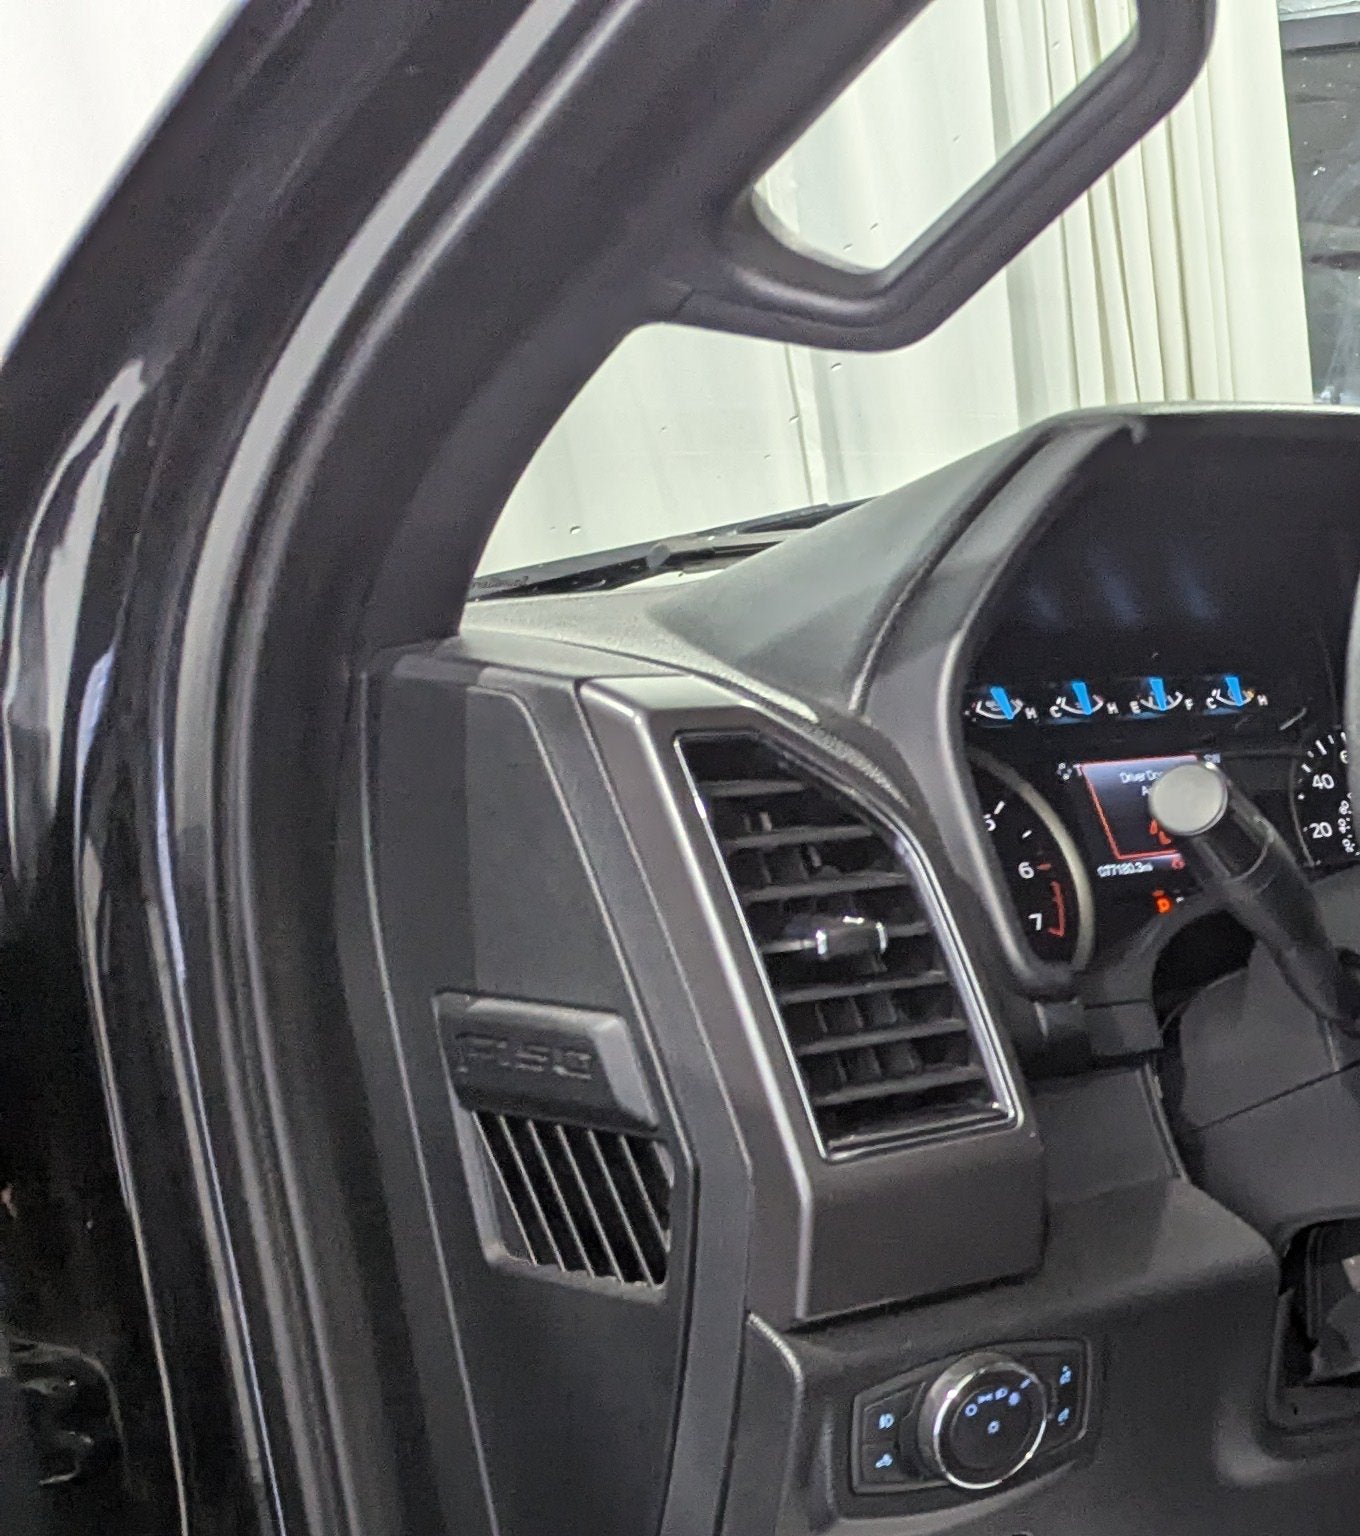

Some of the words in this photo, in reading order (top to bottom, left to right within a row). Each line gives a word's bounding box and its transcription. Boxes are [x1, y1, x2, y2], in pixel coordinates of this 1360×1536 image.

[1312, 773, 1335, 790] 40
[1309, 821, 1333, 839] 20
[1018, 861, 1035, 880] 6
[1028, 912, 1043, 931] 7
